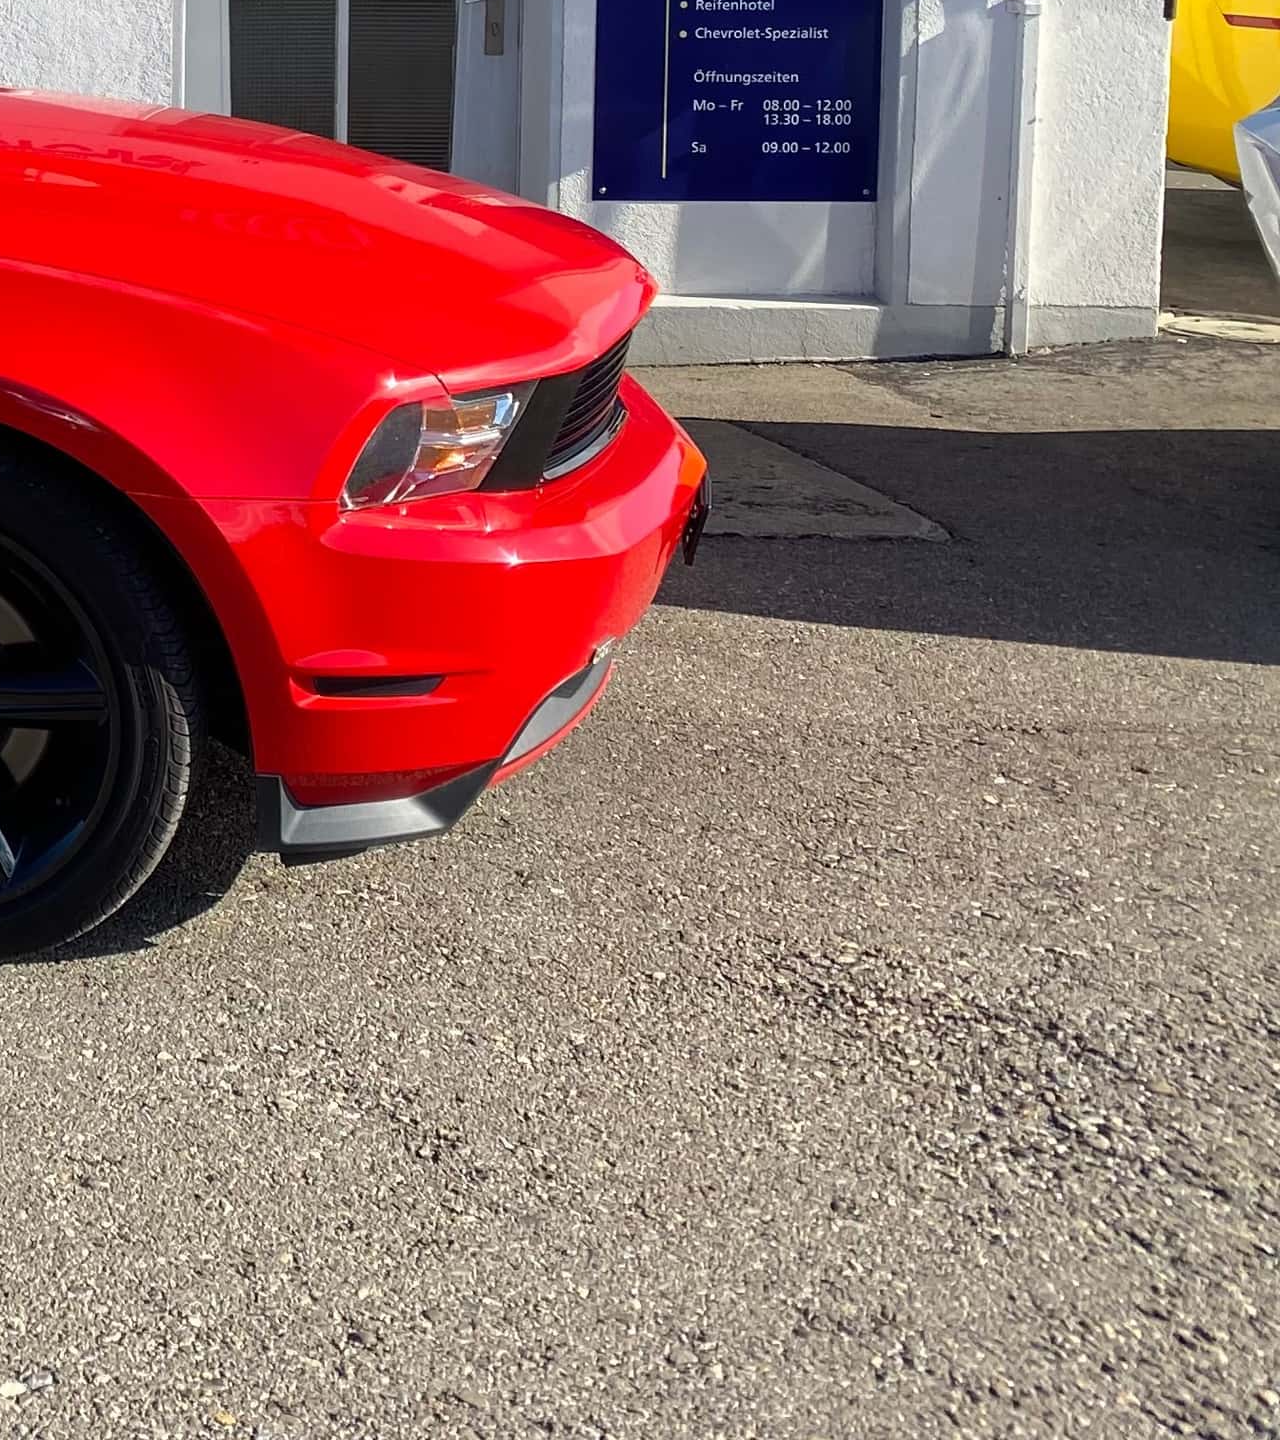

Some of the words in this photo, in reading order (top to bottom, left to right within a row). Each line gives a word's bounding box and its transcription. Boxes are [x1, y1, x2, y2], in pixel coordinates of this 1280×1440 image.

[694, 27, 829, 41] Chevrolet-Spezialist
[693, 69, 799, 85] Öffnungszeiten
[693, 99, 716, 111] Mo
[730, 99, 744, 111] Fr
[763, 99, 800, 111] 08.00
[816, 99, 852, 111] 12.00
[763, 113, 800, 125] 13.30
[816, 113, 852, 125] 18.00
[691, 141, 707, 153] Sa
[761, 142, 798, 153] 09.00
[814, 142, 850, 153] 12.00
